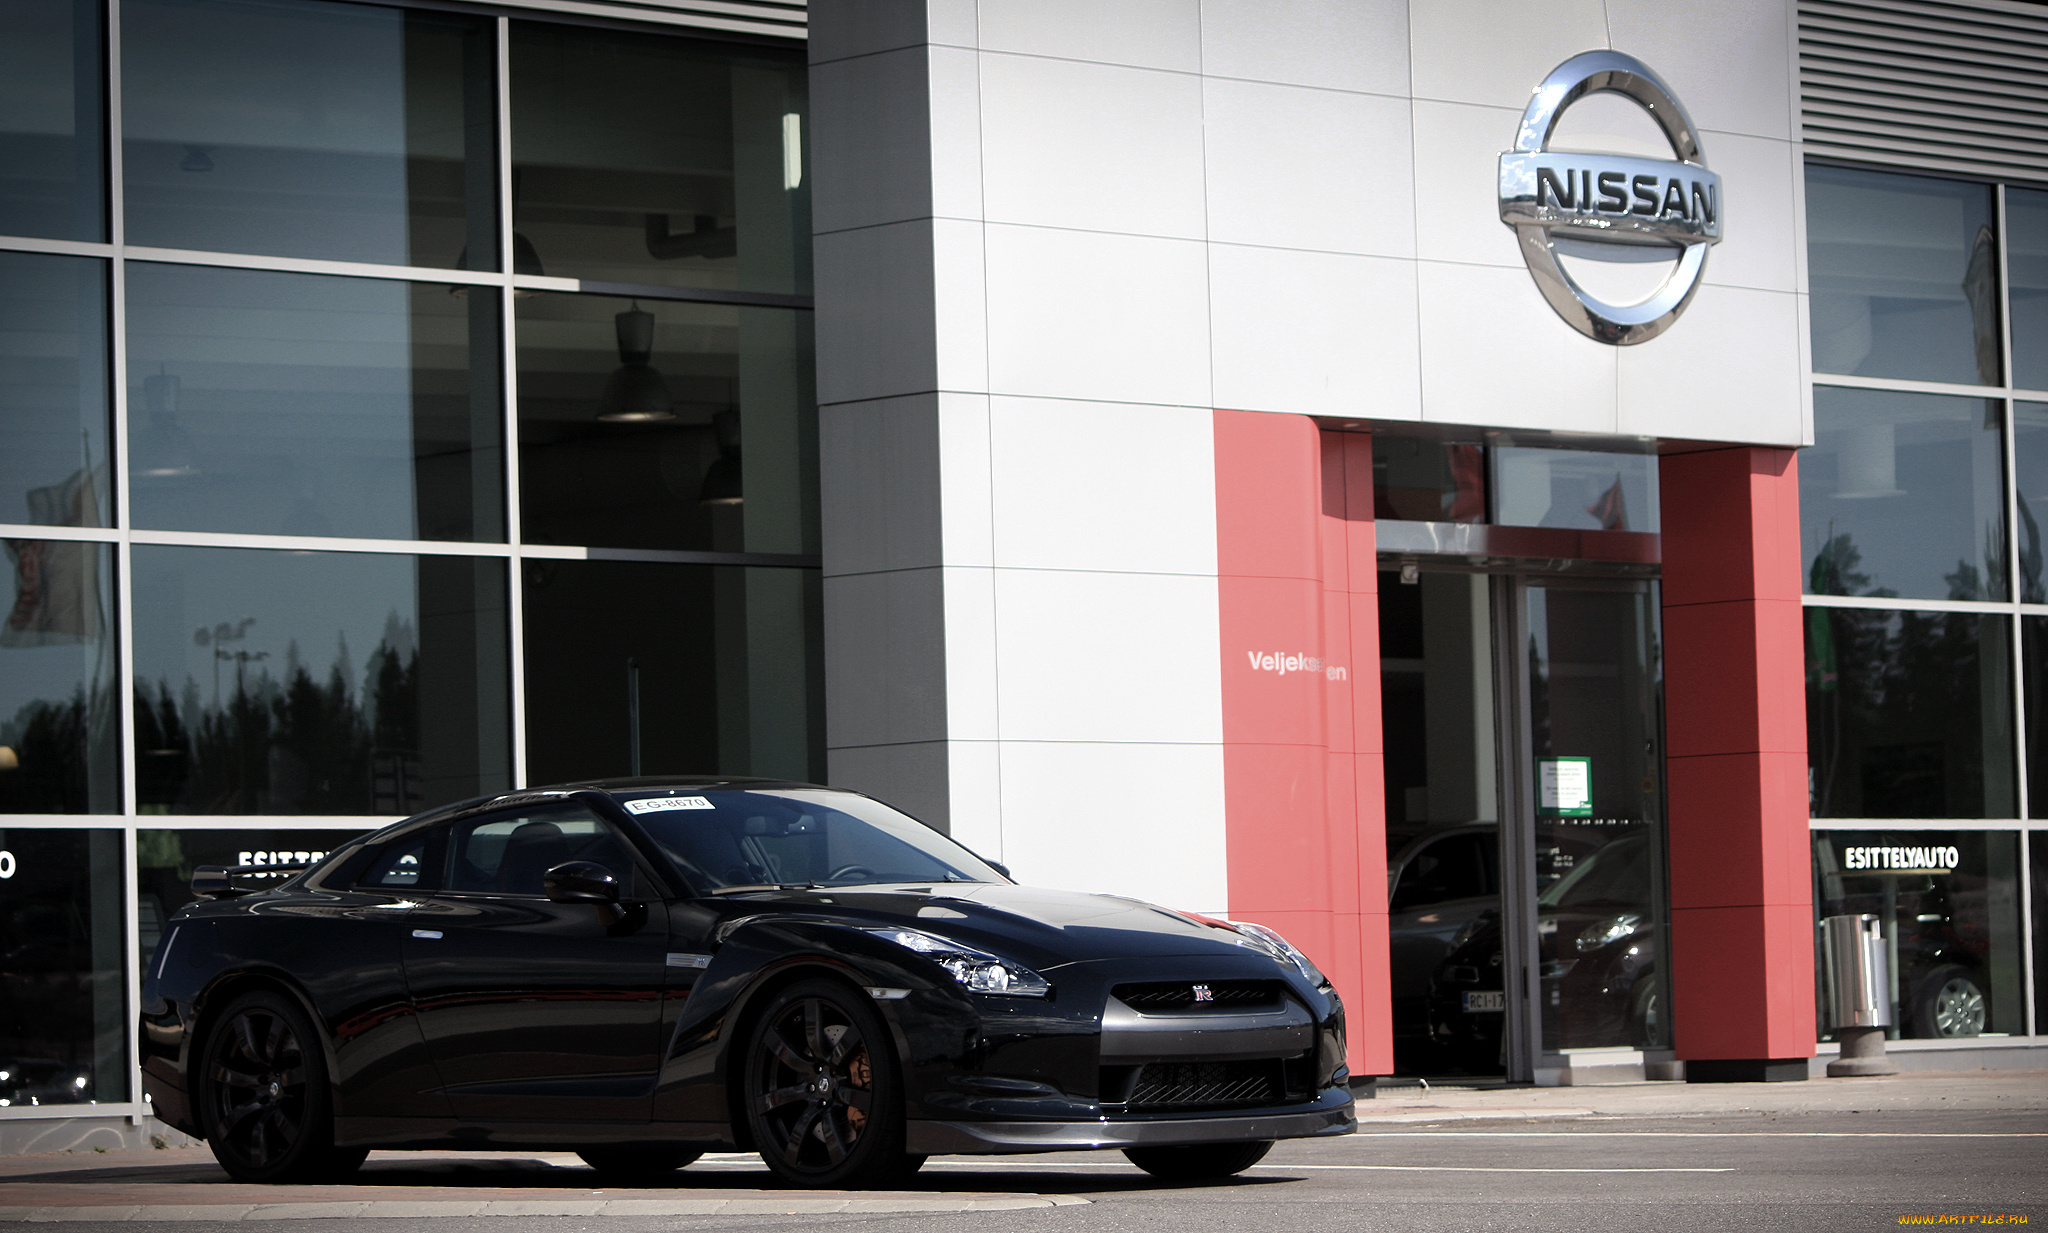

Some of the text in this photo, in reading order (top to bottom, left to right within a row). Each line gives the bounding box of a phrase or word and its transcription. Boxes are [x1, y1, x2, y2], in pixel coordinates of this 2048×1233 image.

[1537, 167, 1716, 224] NISSAN
[632, 799, 706, 811] EG-8670
[1845, 846, 1959, 869] ESITTELYAUTO
